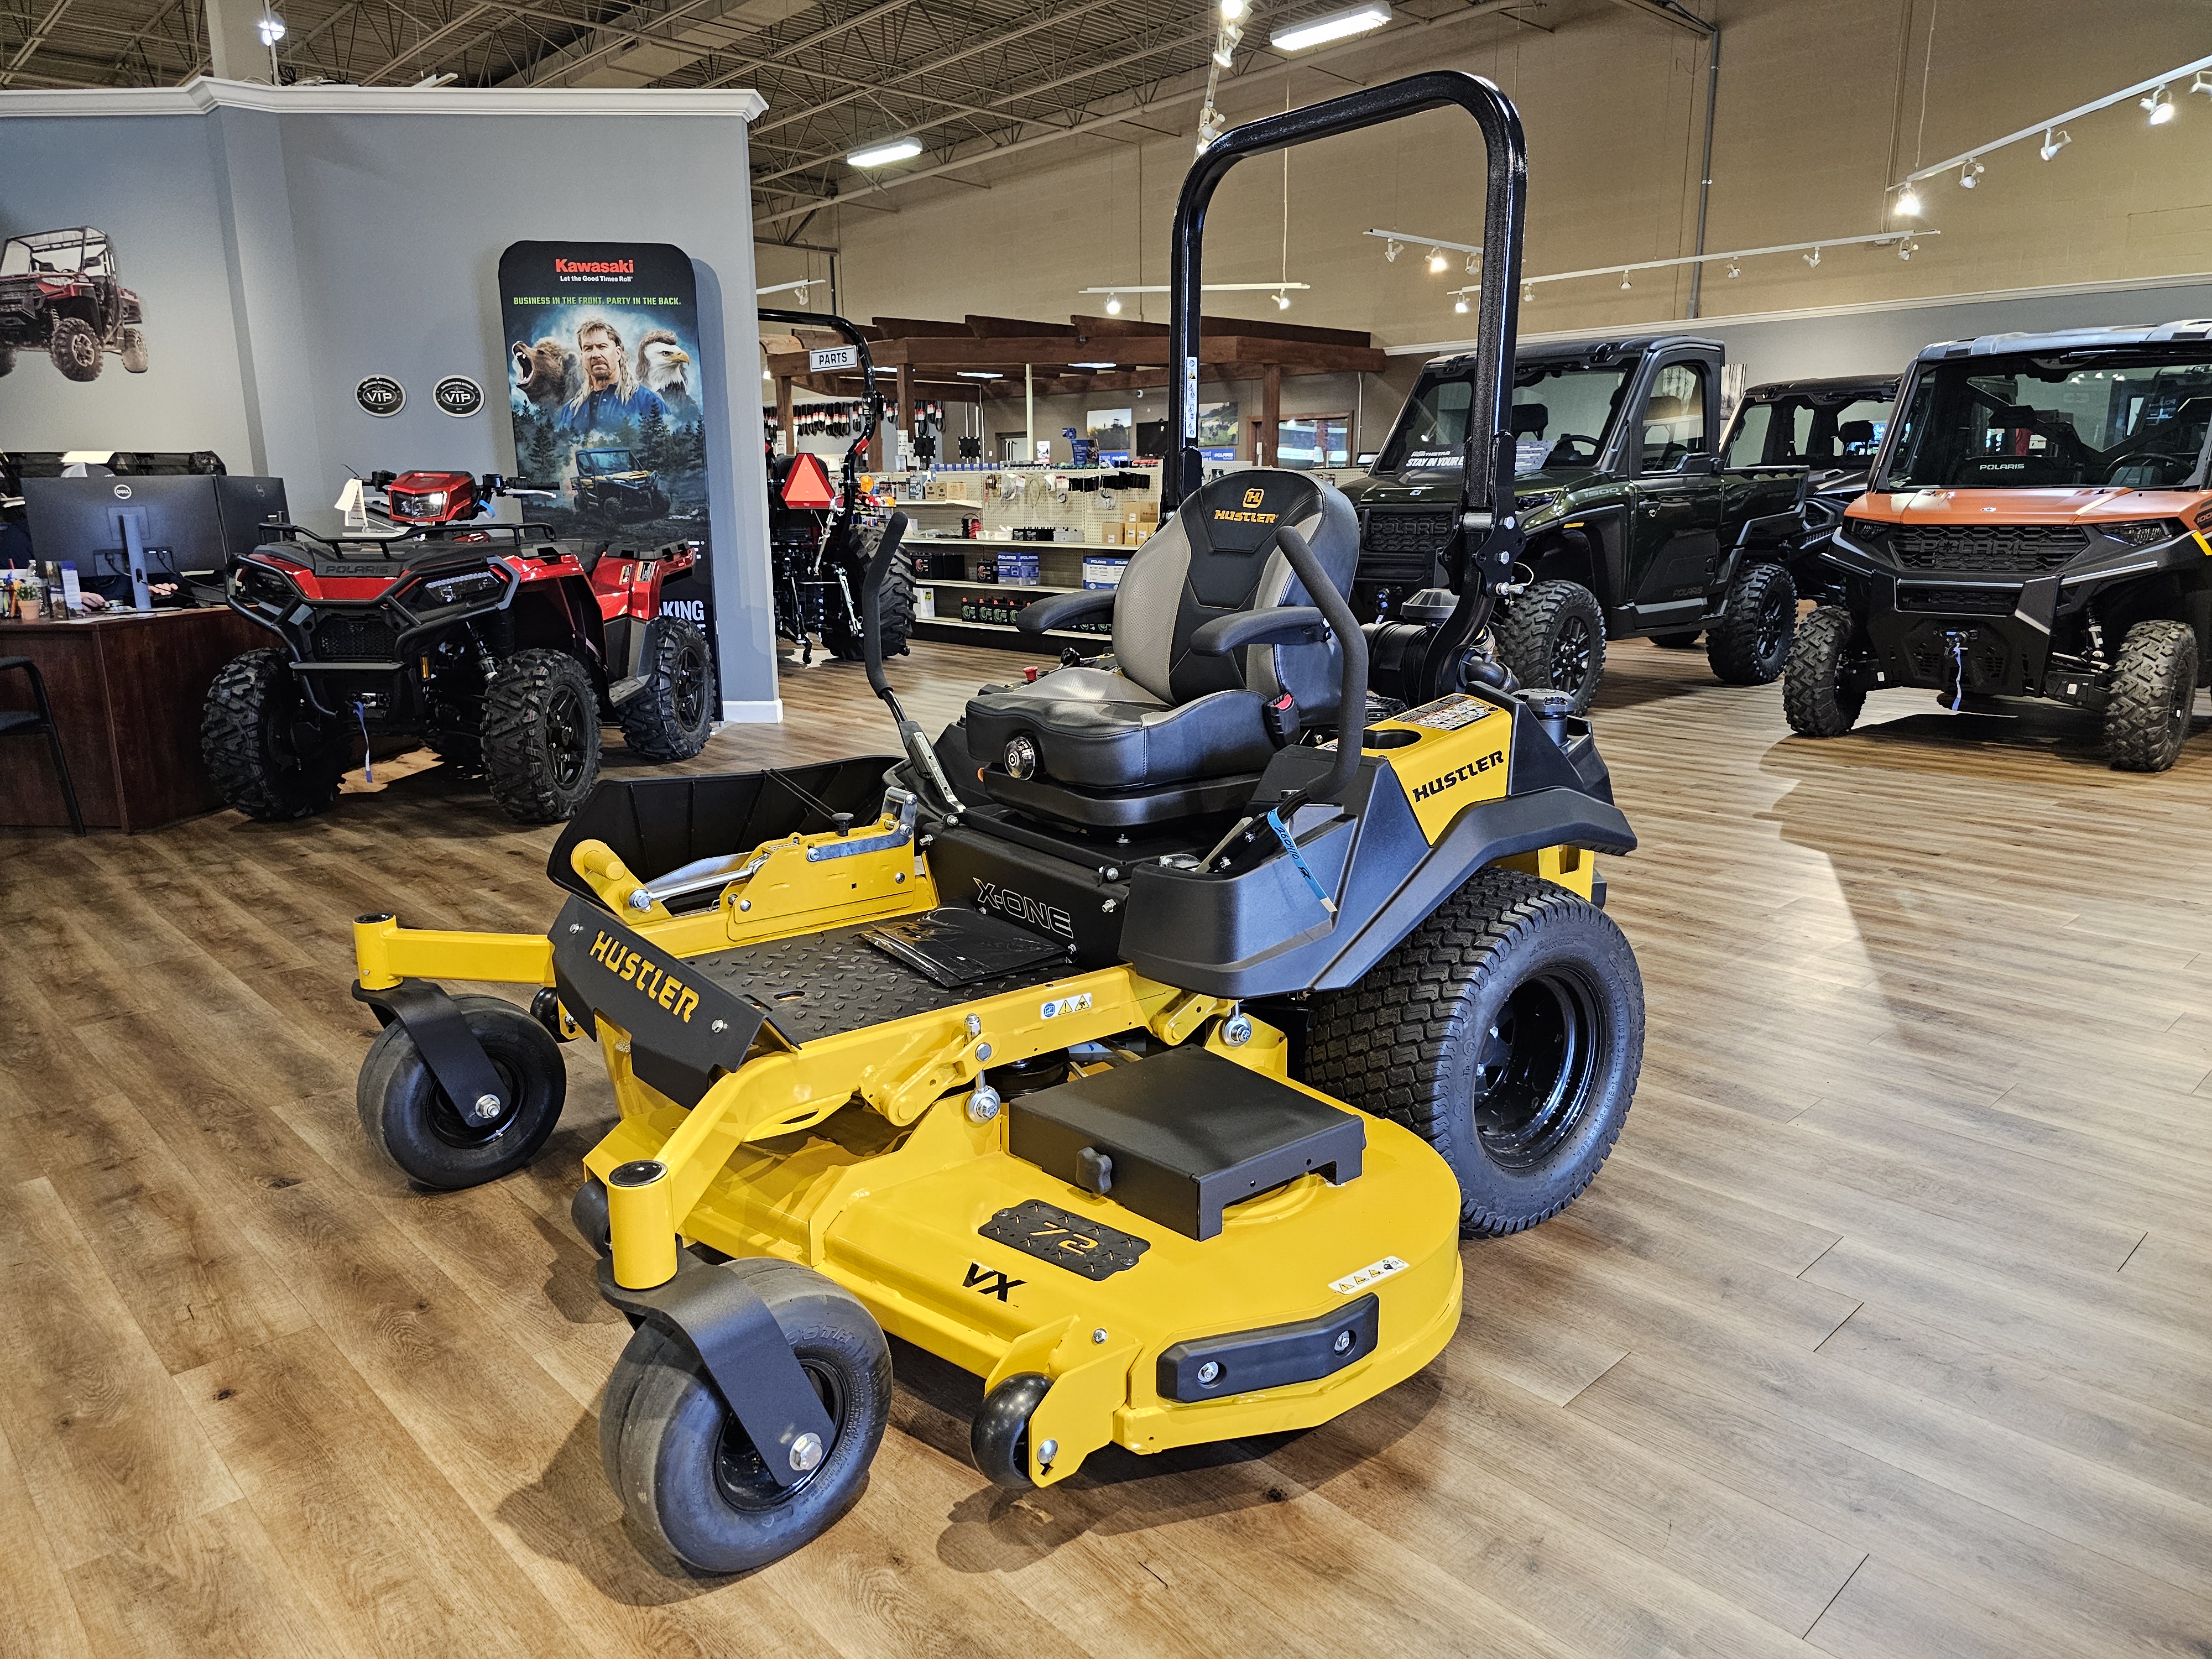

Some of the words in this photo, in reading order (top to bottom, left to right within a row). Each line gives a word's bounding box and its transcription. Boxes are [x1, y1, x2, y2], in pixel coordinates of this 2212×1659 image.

[555, 258, 634, 273] Kawasaki
[819, 352, 847, 366] PARTS
[367, 393, 392, 402] VIP
[445, 393, 471, 403] VIP
[1406, 458, 1428, 467] STAY
[1426, 458, 1438, 467] IN
[1437, 457, 1460, 467] YOUR
[1584, 487, 1619, 498] 1500
[1214, 509, 1276, 524] HUSTLER
[2197, 512, 2212, 524] 100
[1371, 523, 1447, 535] POLARIS
[1919, 540, 2039, 554] POLARIS
[325, 566, 389, 574] POLARIS
[659, 601, 705, 620] KING
[1412, 750, 1504, 802] HUSTLER
[1274, 827, 1300, 859] 260410
[973, 877, 1074, 938] X-ONE
[589, 930, 700, 1023] HUSTLER
[1030, 1221, 1099, 1255] 72
[962, 1262, 1027, 1303] VX
[785, 1325, 854, 1345] OOTH
